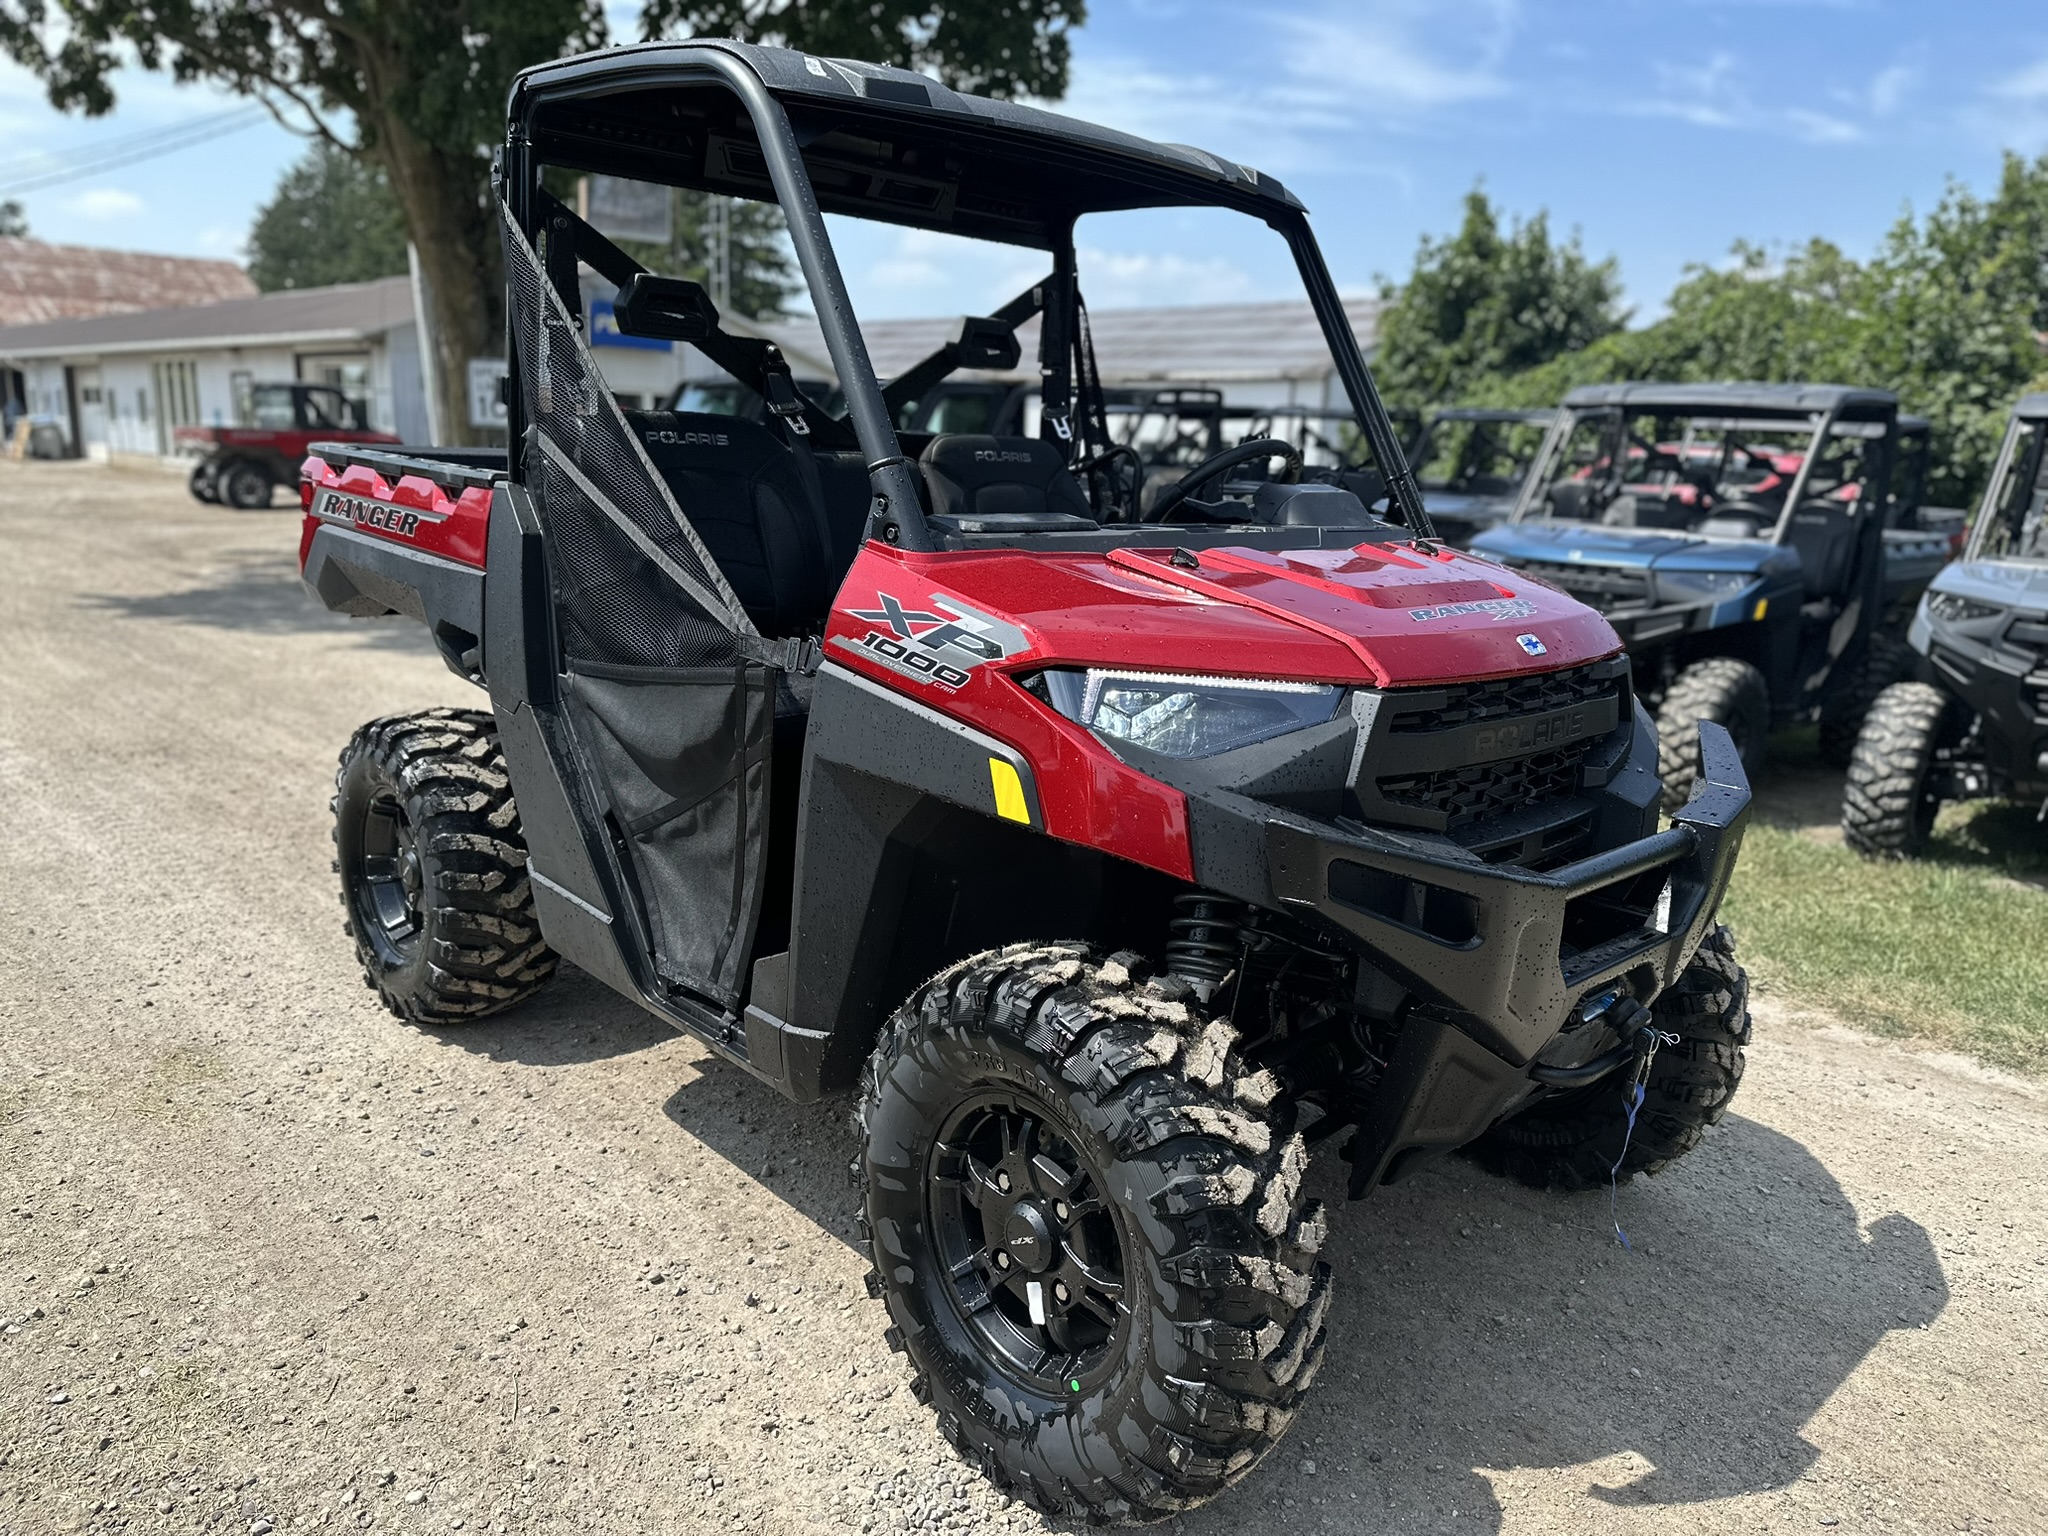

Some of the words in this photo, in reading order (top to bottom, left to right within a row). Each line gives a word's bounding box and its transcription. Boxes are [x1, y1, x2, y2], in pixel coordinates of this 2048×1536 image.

[645, 431, 729, 446] POLARIS
[974, 450, 1032, 463] POLARIS
[322, 492, 420, 537] RANGER
[841, 591, 1006, 662] XP
[1408, 599, 1534, 622] RANGER
[858, 647, 881, 662] DUAL
[881, 658, 933, 685] OVERHEAD
[933, 681, 958, 696] CAM
[862, 630, 971, 689] 1000
[1474, 711, 1586, 755] POLARIS
